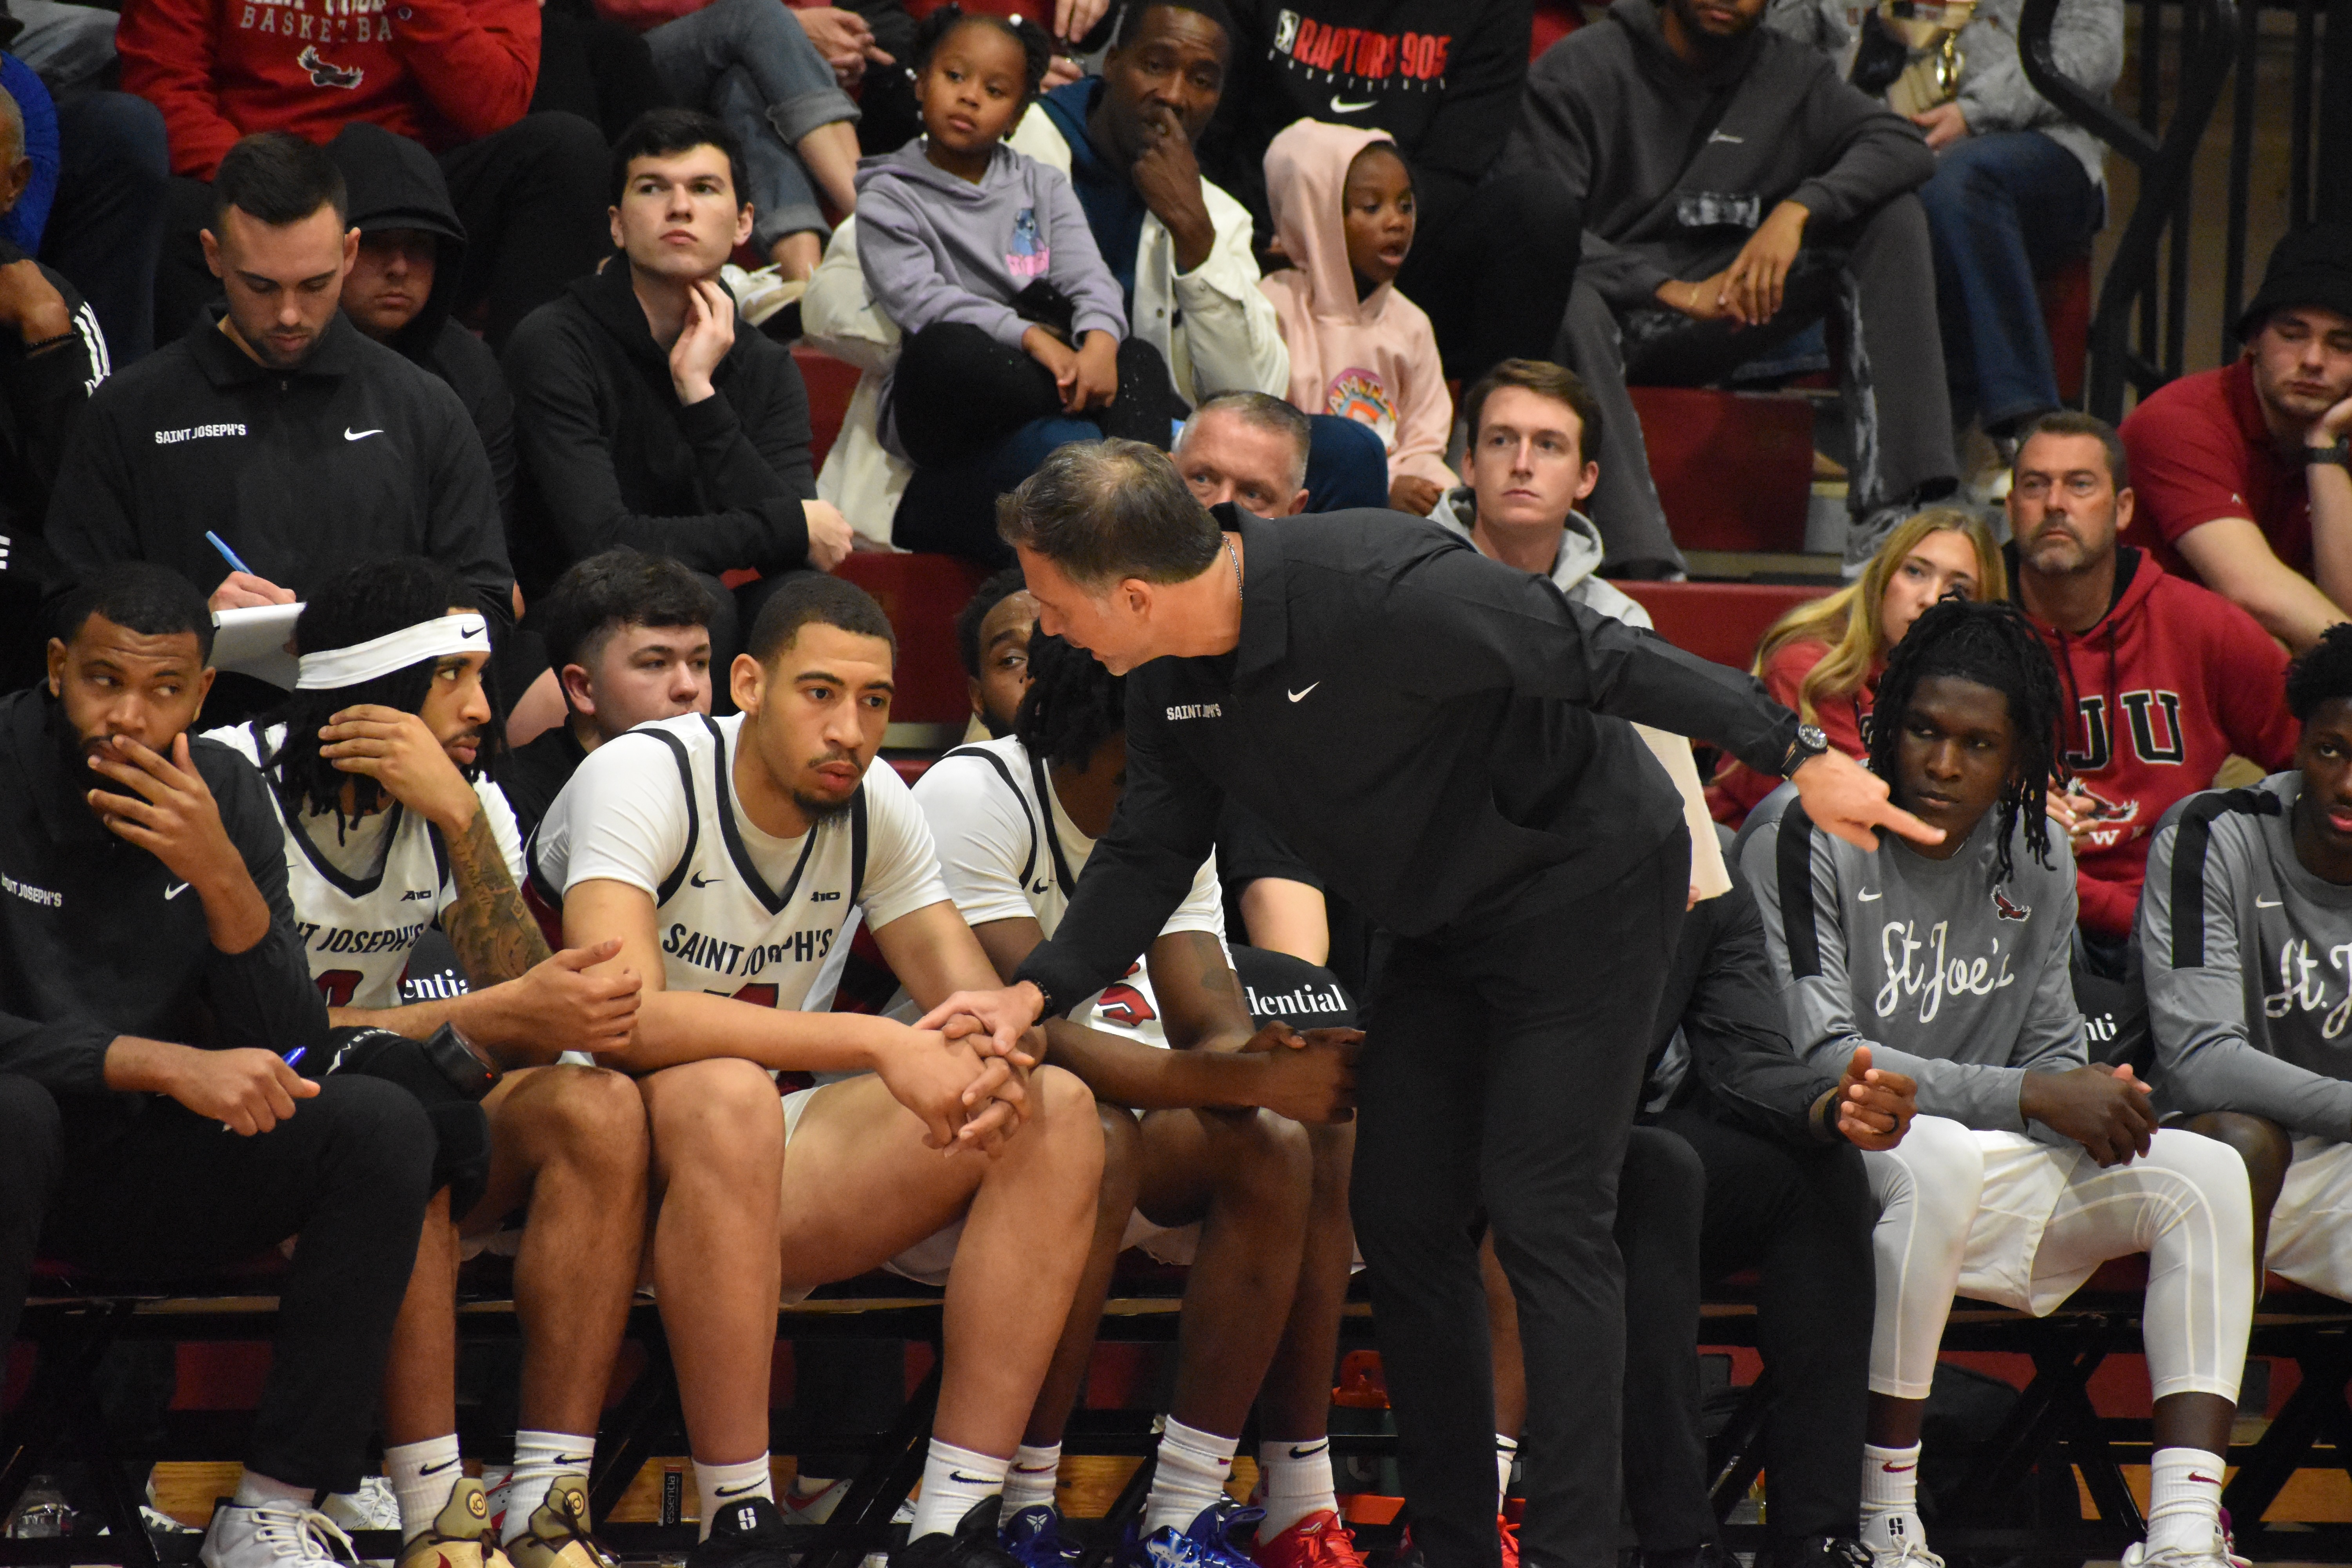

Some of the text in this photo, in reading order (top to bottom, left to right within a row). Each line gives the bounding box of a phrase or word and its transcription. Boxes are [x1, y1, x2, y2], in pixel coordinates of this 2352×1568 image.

[155, 424, 246, 444] SAINT JOSEPH'S
[1166, 704, 1201, 720] SAINT
[18, 883, 62, 907] JOSEPH'S
[316, 923, 424, 953] JOSEPH'S
[662, 923, 745, 975] SAINT
[1245, 984, 1348, 1015] dential
[666, 1475, 676, 1524] essentia
